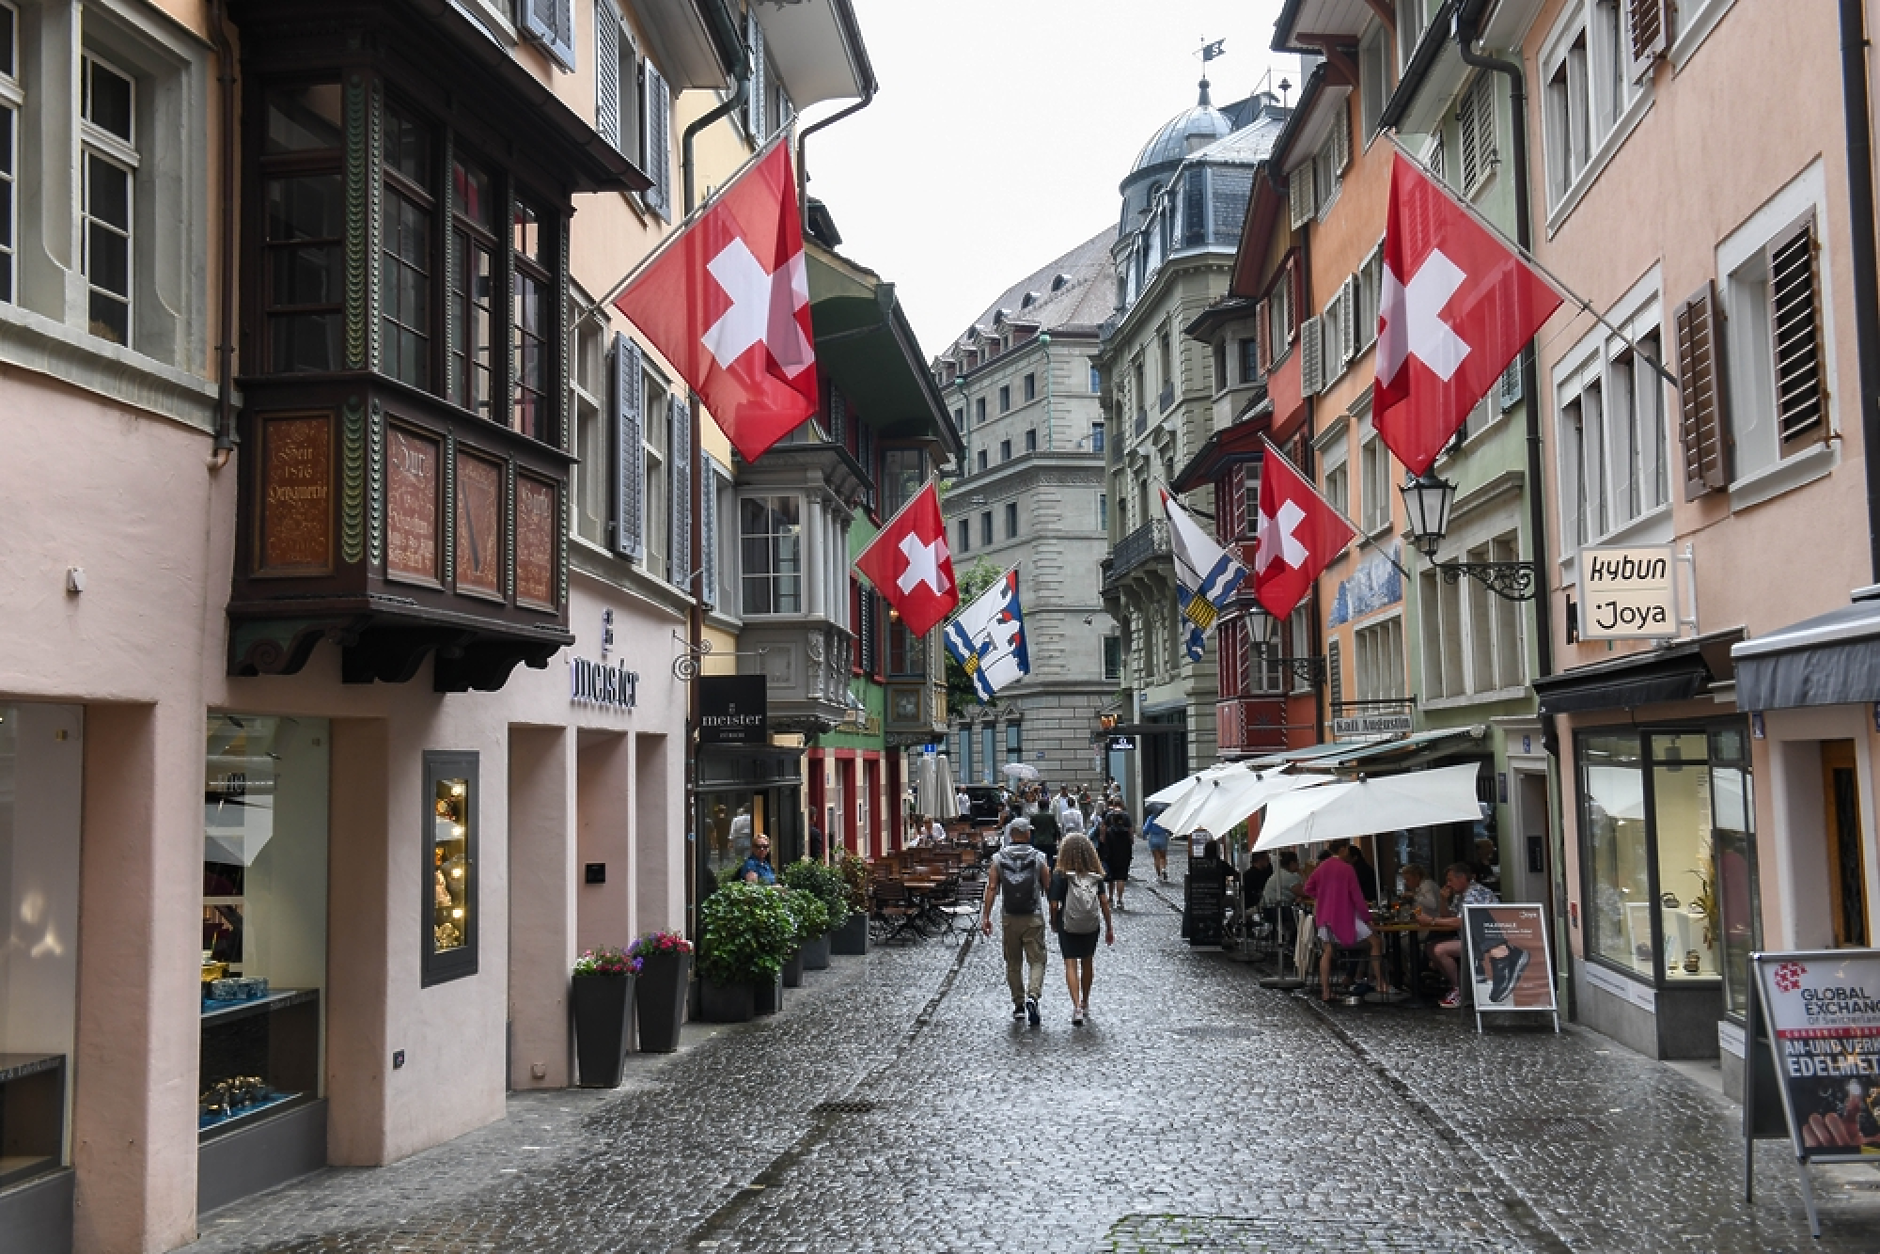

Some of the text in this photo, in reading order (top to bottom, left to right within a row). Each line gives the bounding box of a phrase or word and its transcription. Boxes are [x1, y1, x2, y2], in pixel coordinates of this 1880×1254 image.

[1590, 554, 1667, 582] kybun
[570, 656, 640, 709] meister
[702, 713, 763, 727] meister
[1801, 986, 1871, 1001] GLOBAL
